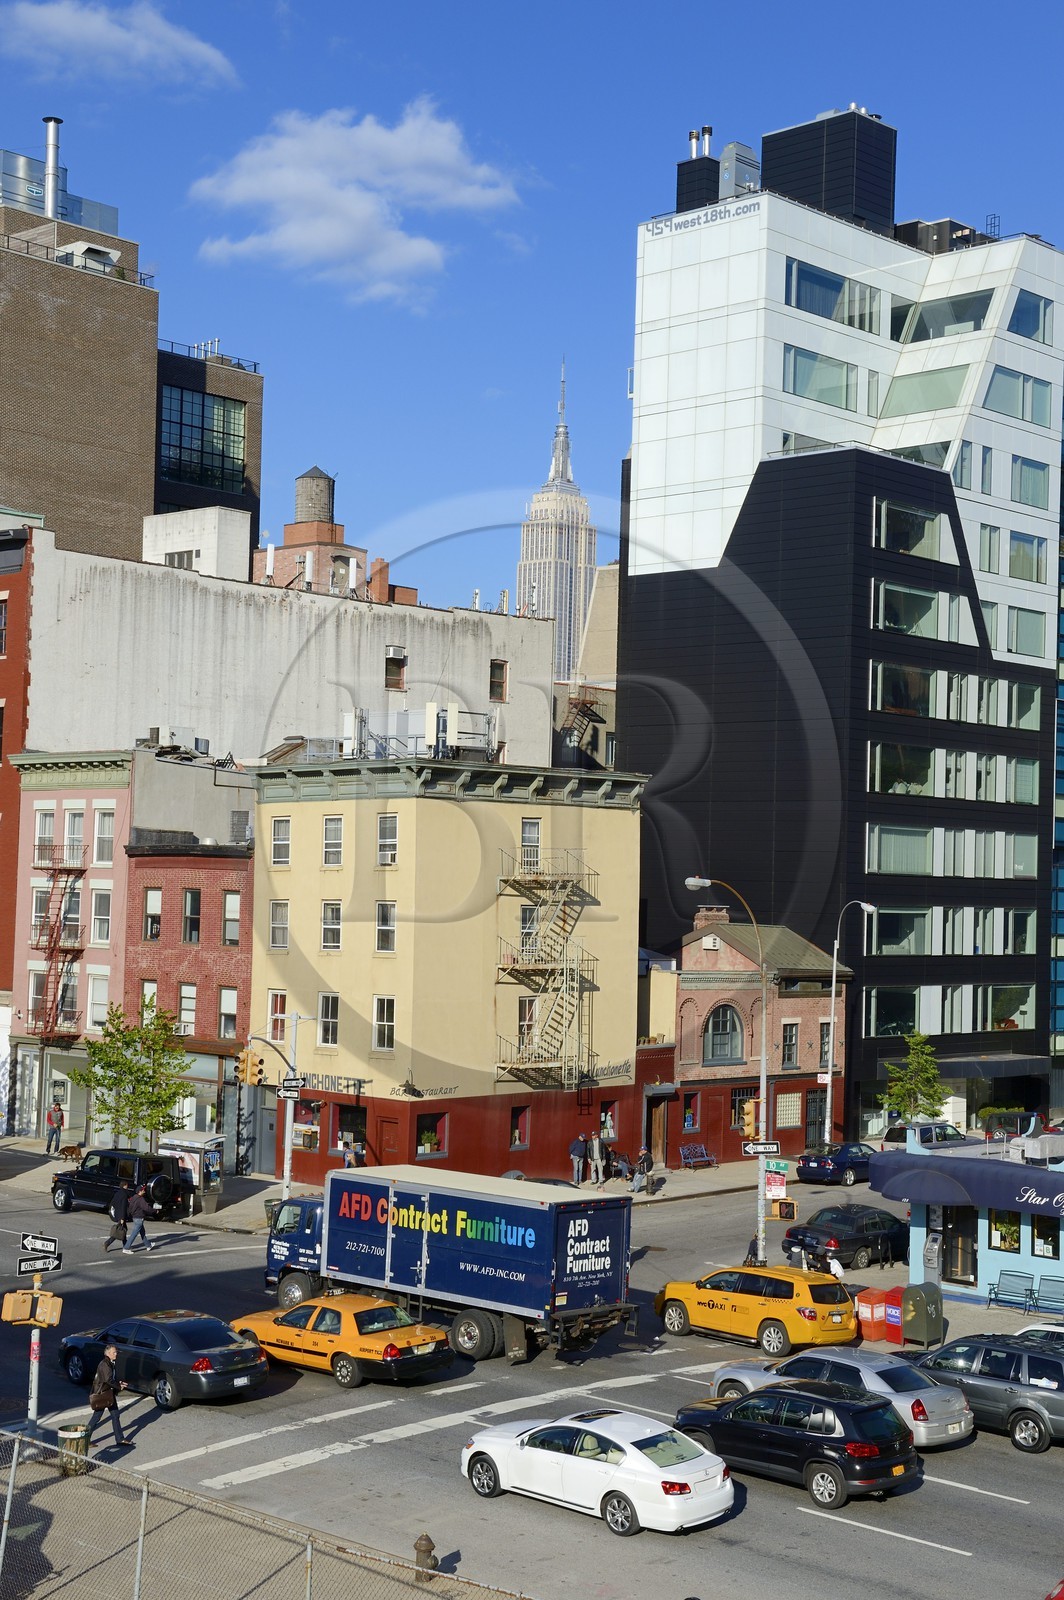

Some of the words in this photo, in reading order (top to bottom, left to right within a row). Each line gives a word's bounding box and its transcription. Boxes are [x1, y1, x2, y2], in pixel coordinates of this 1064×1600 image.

[769, 1160, 777, 1170] 10
[1015, 1186, 1050, 1206] Star
[338, 1191, 372, 1221] AFD
[376, 1197, 449, 1235] Contract
[455, 1210, 536, 1249] Furniture
[567, 1219, 589, 1238] AFD
[26, 1239, 37, 1248] ONE
[41, 1242, 53, 1250] WAY
[345, 1241, 386, 1257] 212-721-7100
[567, 1236, 610, 1256] Contract
[24, 1261, 37, 1270] ONE
[42, 1258, 56, 1267] WAY
[459, 1262, 526, 1282] WWW.AFD-INC.COM
[566, 1255, 611, 1274] Furniture
[697, 1300, 707, 1308] NYC
[707, 1299, 726, 1311] TAXI
